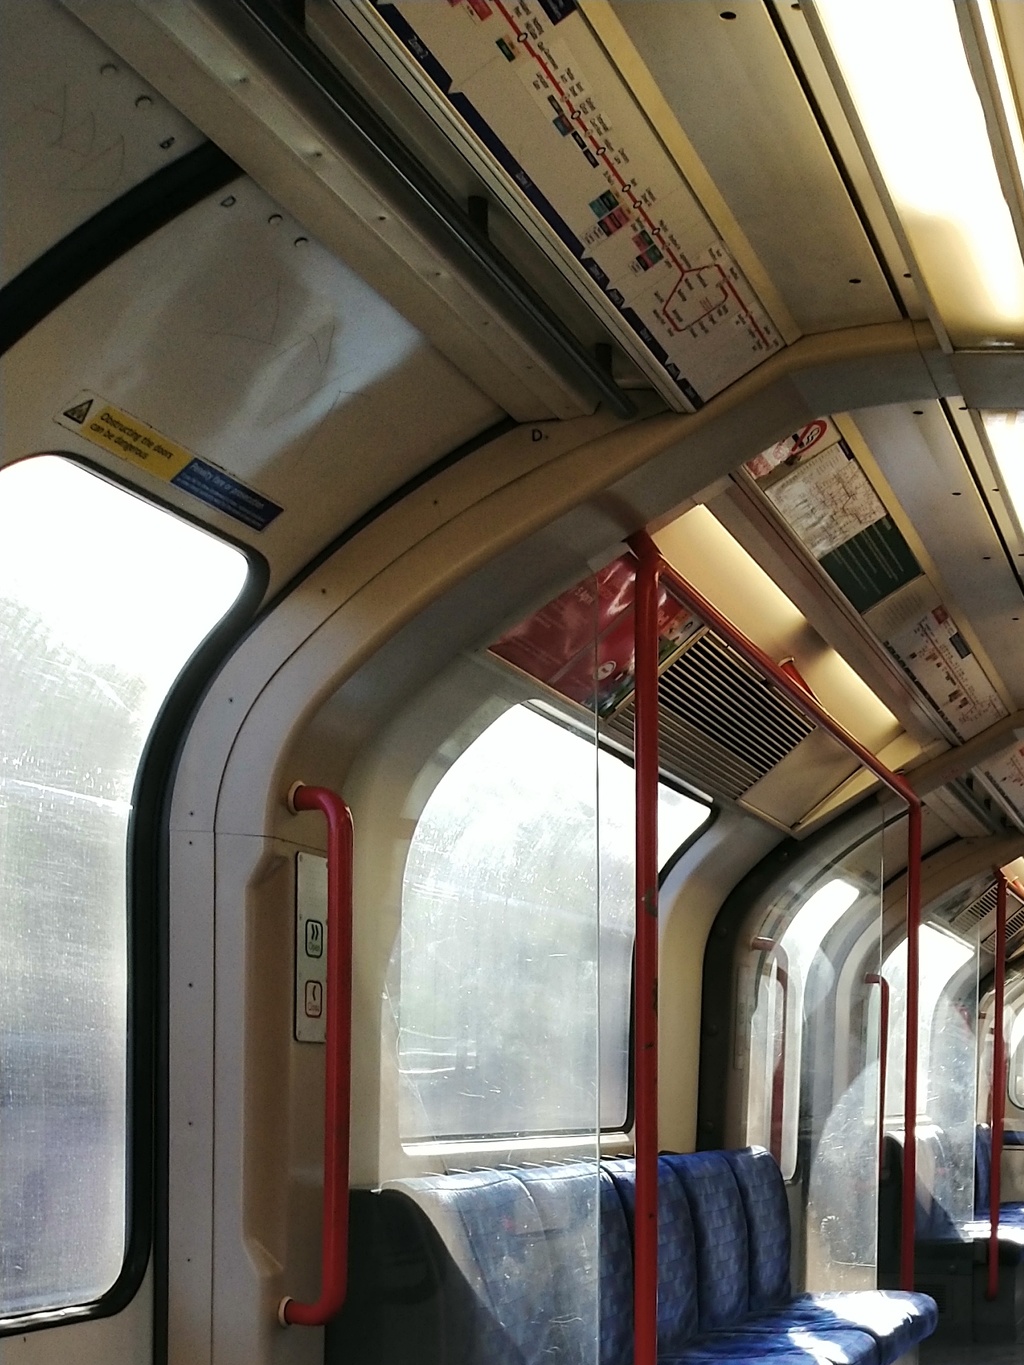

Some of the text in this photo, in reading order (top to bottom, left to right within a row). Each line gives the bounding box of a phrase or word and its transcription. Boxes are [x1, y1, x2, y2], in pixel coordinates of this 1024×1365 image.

[90, 423, 149, 460] can be dangerous
[101, 413, 174, 459] Obstructing the doors
[190, 462, 212, 480] Penalty
[212, 475, 226, 487] fare
